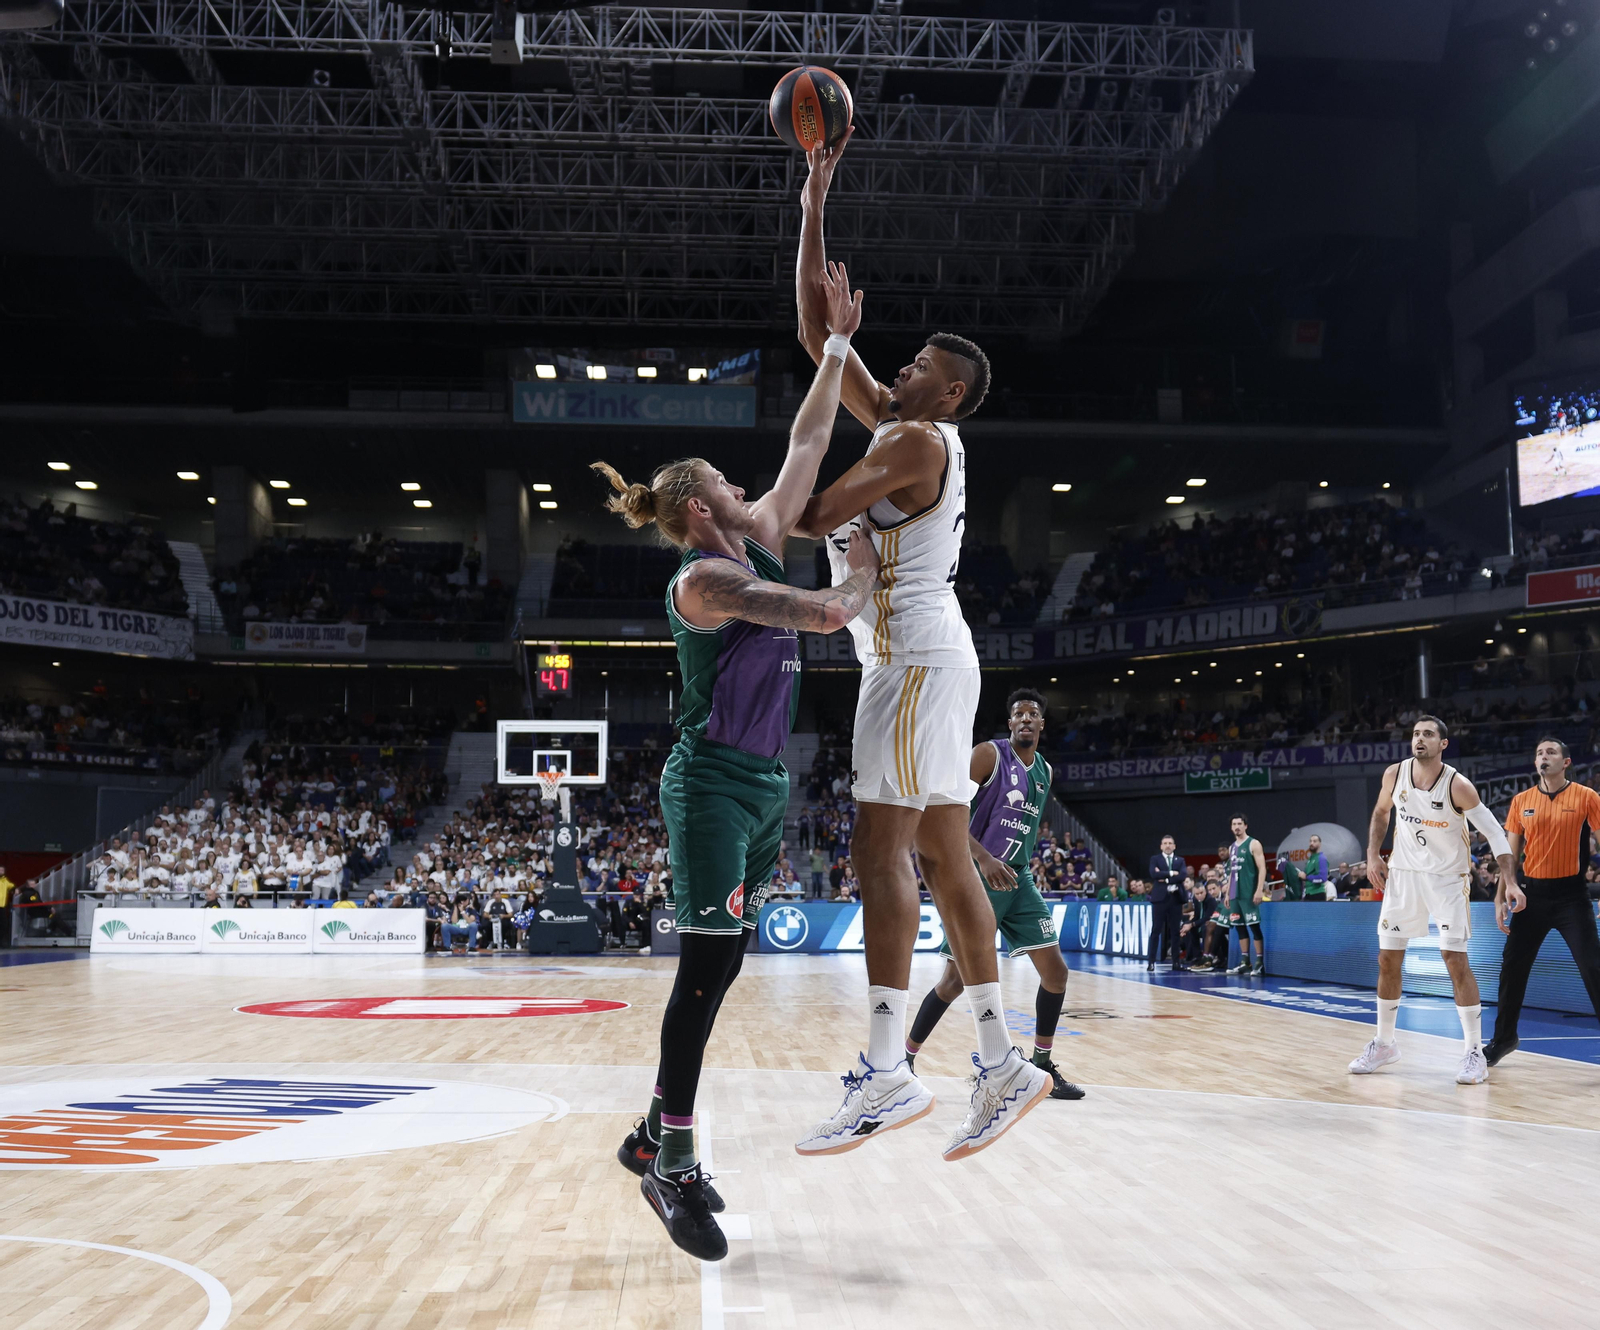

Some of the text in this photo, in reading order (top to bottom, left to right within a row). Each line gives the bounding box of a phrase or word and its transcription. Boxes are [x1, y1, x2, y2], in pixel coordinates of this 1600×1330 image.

[522, 388, 748, 422] WiZinkCenter
[53, 605, 94, 629] DEL
[98, 611, 158, 636] TIGRE
[27, 629, 102, 645] TERRITORIO
[269, 626, 345, 641] LOS OJOS DEL TIGRE
[1054, 622, 1134, 658] REAL
[1145, 605, 1277, 648] MADRID
[1066, 755, 1207, 780] BERSERKERS
[1241, 750, 1306, 767] REAL
[1210, 776, 1243, 790] EXIT
[1415, 829, 1427, 847] 6
[1001, 837, 1023, 861] 77
[128, 931, 196, 942] Unicaja Banco
[239, 931, 306, 942] Unicaja Banco
[349, 931, 416, 942] Unicaja Banco
